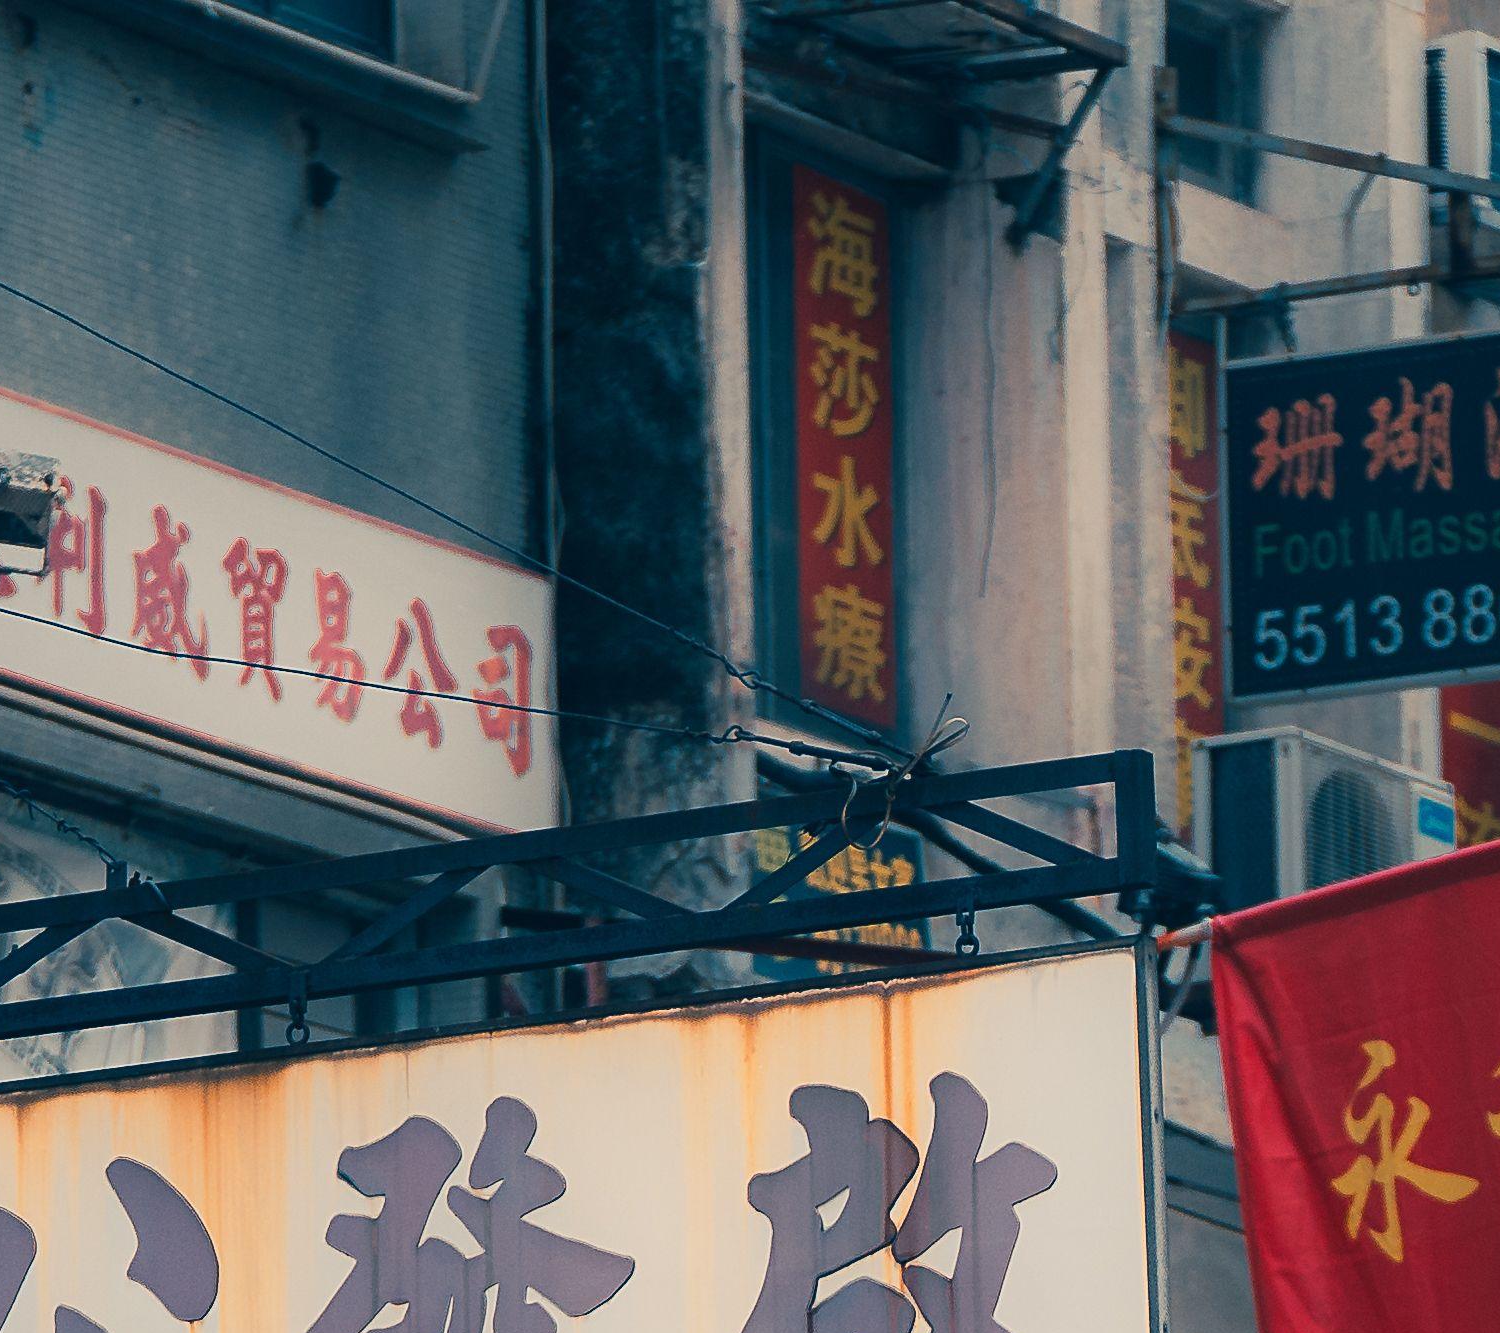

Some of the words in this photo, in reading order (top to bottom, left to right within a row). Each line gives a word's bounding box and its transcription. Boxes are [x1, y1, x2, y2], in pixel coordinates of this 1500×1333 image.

[808, 193, 888, 706] 海莎水療
[1253, 519, 1353, 578] Foot
[1253, 594, 1404, 671] 5513
